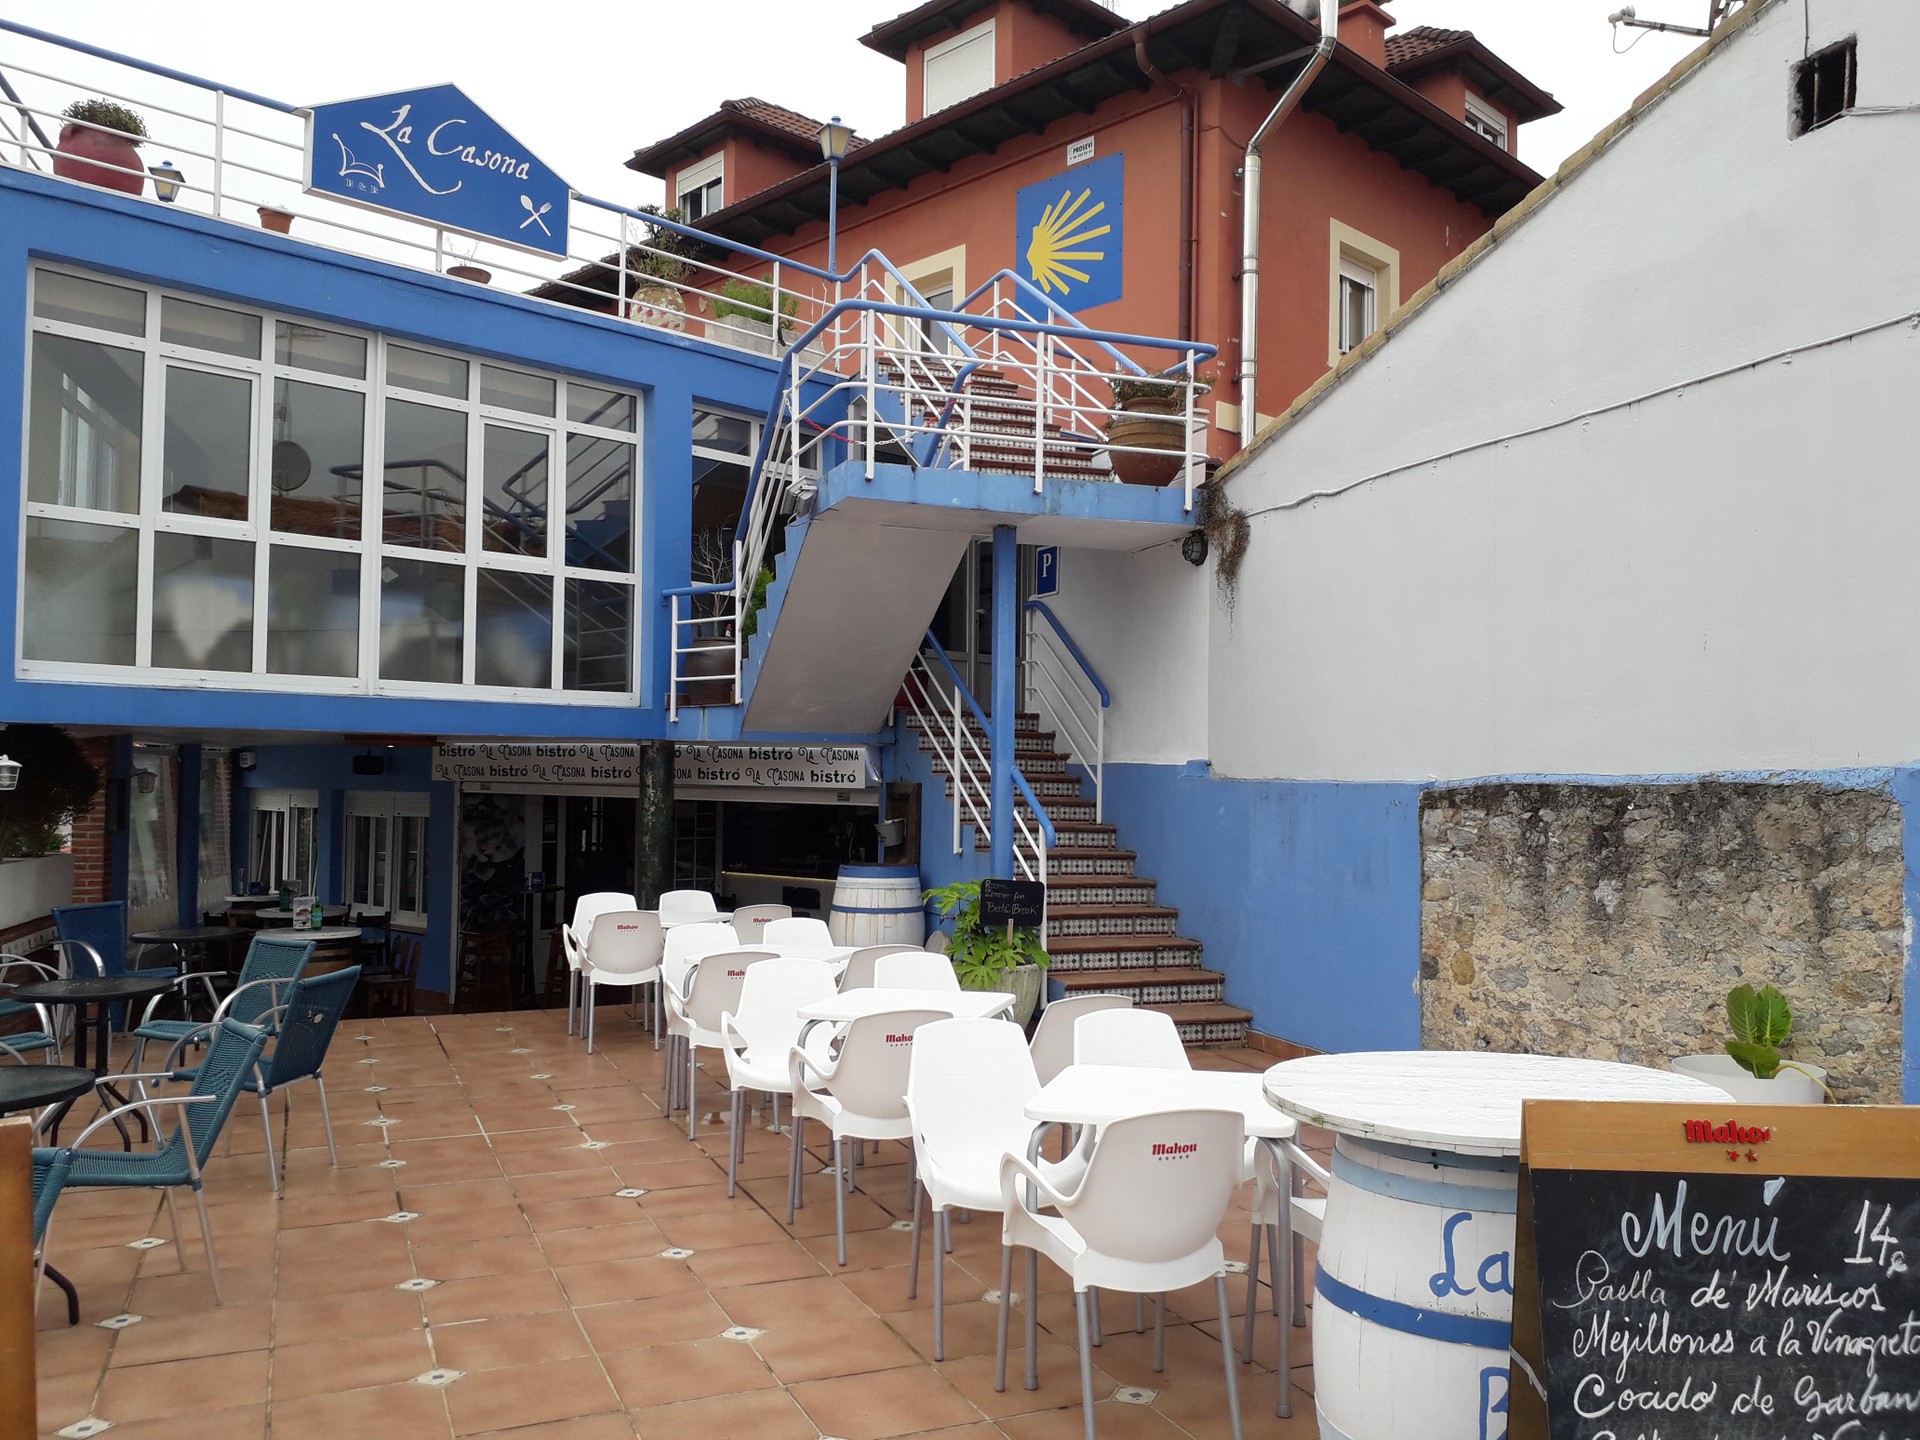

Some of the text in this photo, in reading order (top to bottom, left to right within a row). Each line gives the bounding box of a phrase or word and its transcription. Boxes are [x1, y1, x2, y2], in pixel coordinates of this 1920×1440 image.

[360, 104, 530, 195] La Casona
[1042, 553, 1052, 578] P
[439, 745, 476, 757] bistró
[536, 745, 576, 758] bistró
[749, 747, 793, 761] bistró
[489, 765, 528, 777] bistró
[591, 766, 632, 778] bistró
[698, 768, 740, 781] bistró
[810, 770, 857, 783] bistró
[886, 1033, 913, 1043] Maho
[1152, 1142, 1197, 1155] Mahou
[1621, 1177, 1791, 1262] Menú
[1429, 1212, 1514, 1297] La
[1552, 1250, 1667, 1308] Paella
[1746, 1265, 1886, 1312] Mariscos
[1573, 1309, 1734, 1383] Mejillones
[1751, 1335, 1766, 1356] a
[1777, 1317, 1803, 1356] la
[1573, 1374, 1718, 1419] Cocido
[1731, 1375, 1775, 1415] de
